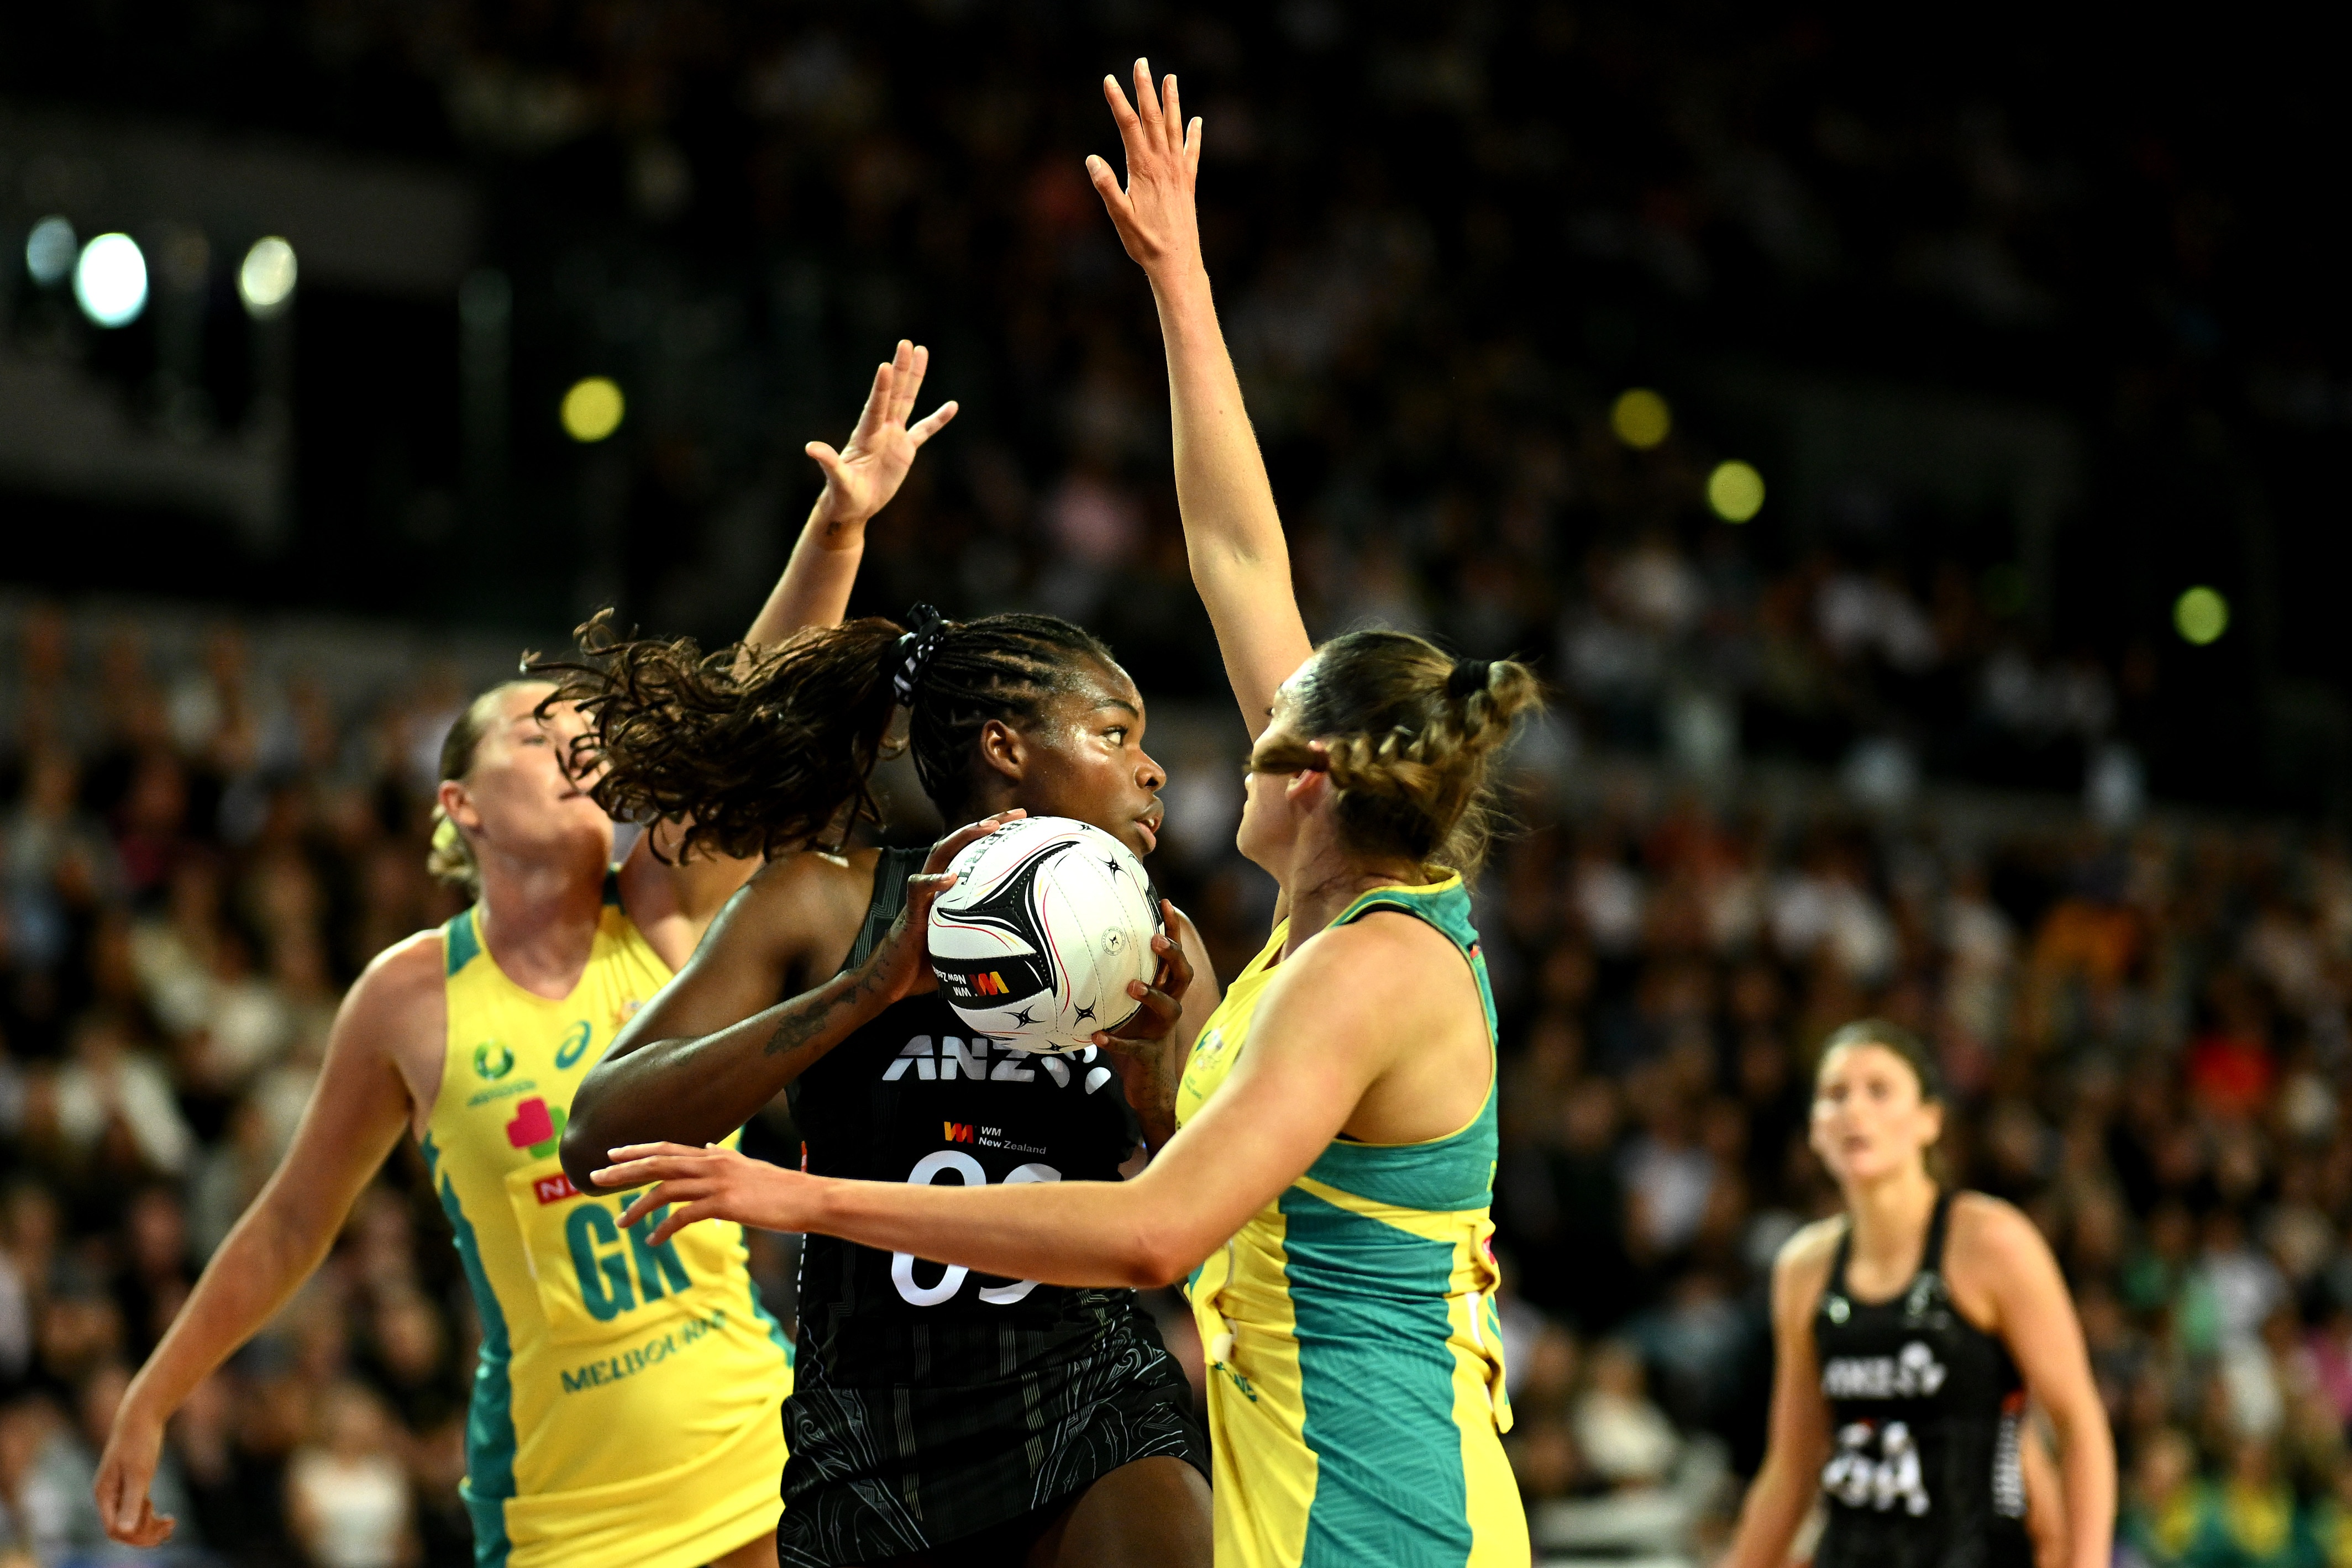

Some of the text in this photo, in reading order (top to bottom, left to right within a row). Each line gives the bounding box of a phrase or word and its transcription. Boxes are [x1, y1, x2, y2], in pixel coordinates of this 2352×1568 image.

[948, 973, 967, 985] New
[952, 986, 972, 997] WM
[882, 1035, 1035, 1082] ANZ
[981, 1126, 1002, 1136] WM
[979, 1137, 1047, 1155] New Zealand
[565, 1186, 693, 1322] GK
